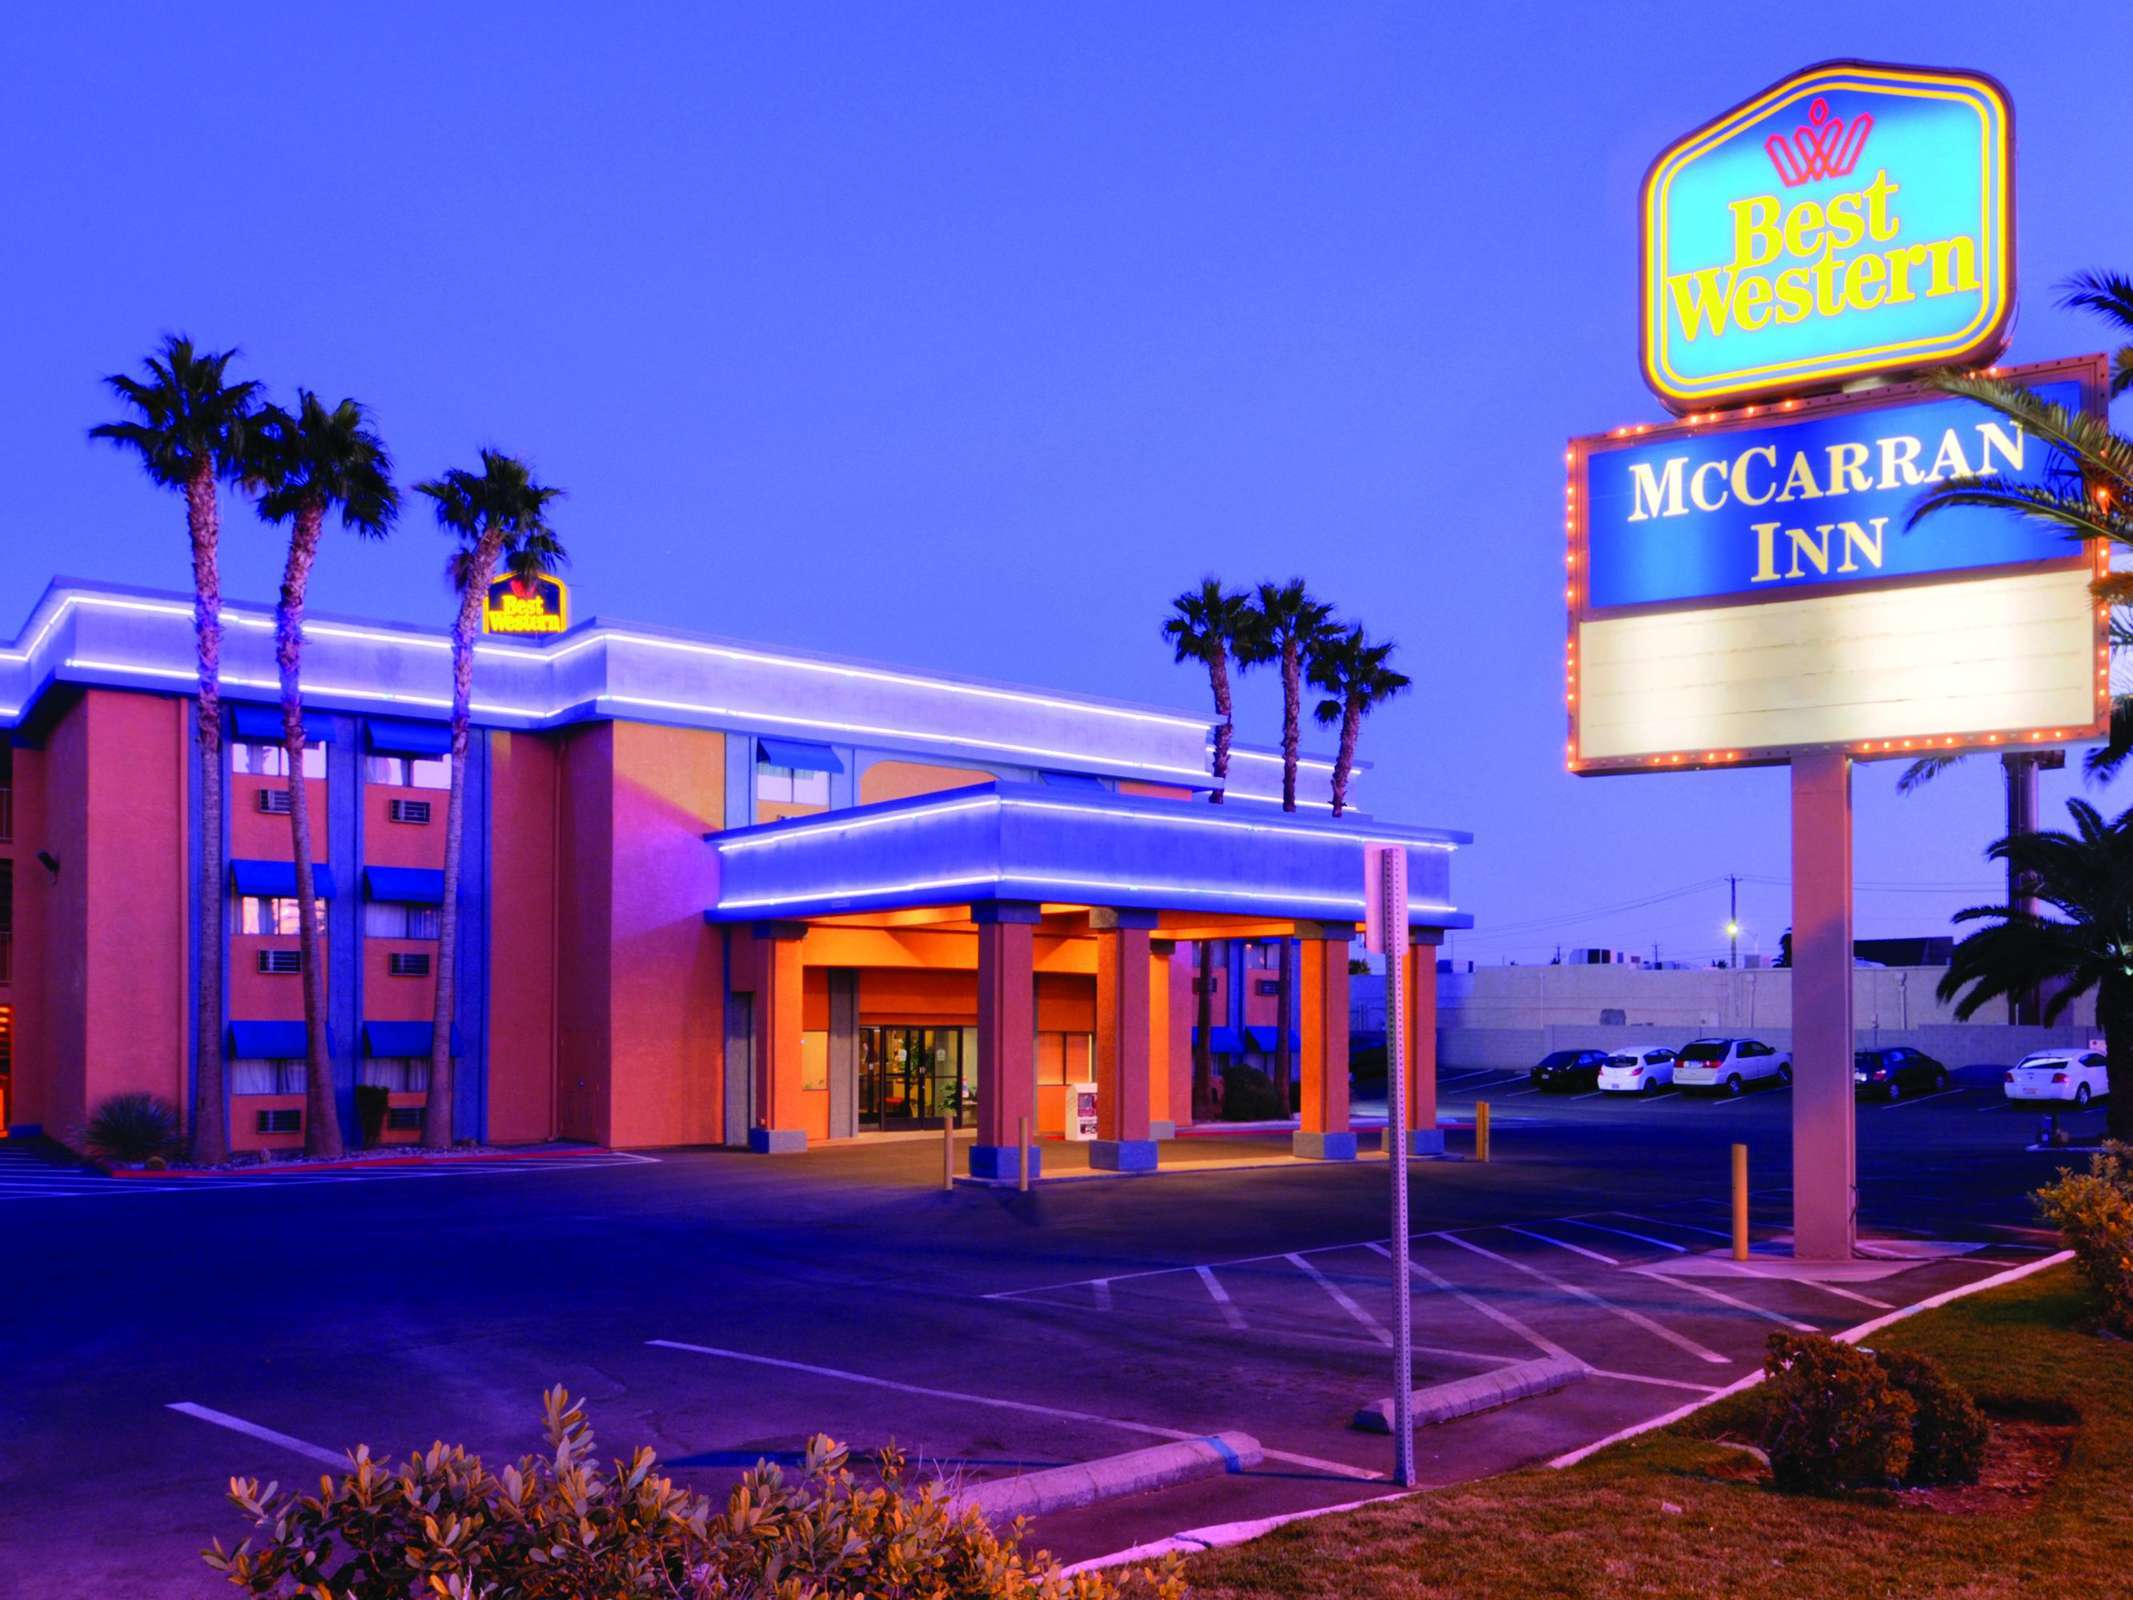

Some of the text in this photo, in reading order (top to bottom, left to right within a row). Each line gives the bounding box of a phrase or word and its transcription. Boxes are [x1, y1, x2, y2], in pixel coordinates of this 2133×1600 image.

[1728, 168, 1900, 270] Best
[1667, 231, 1981, 342] Western
[1751, 517, 1889, 583] INN
[489, 611, 561, 632] Western
[501, 594, 544, 616] Best
